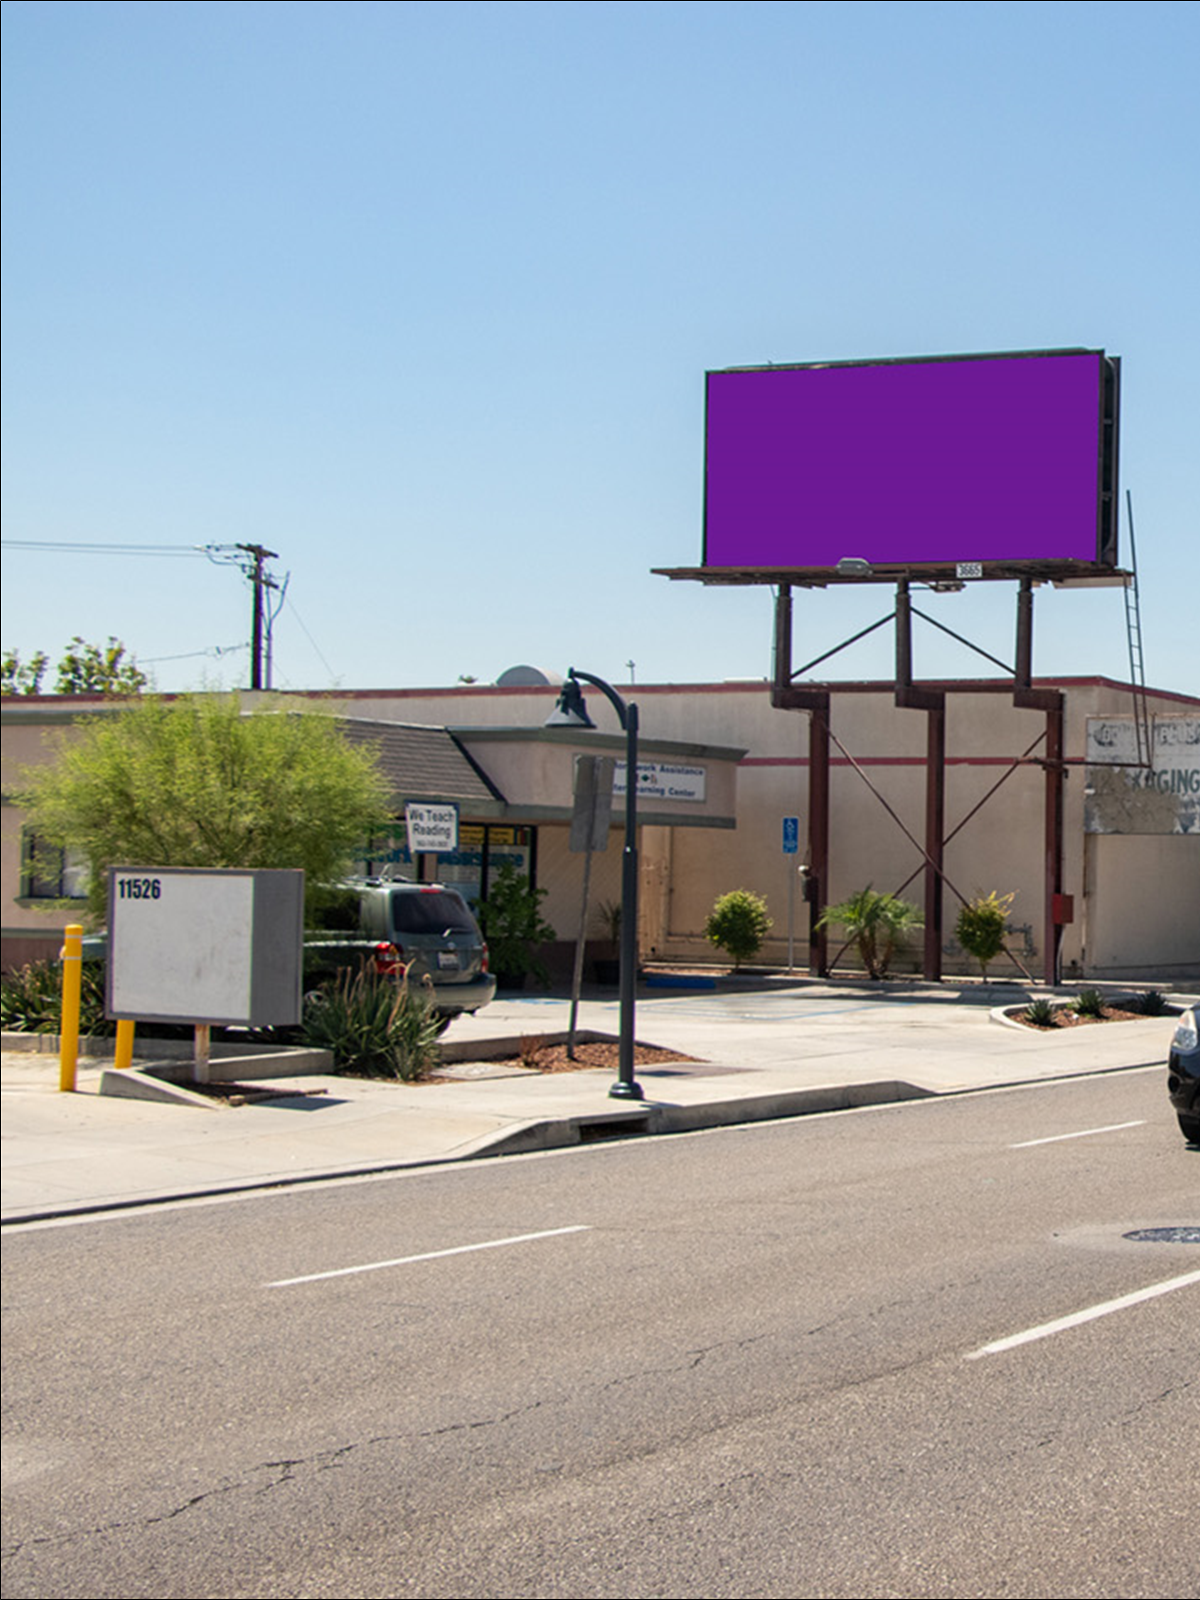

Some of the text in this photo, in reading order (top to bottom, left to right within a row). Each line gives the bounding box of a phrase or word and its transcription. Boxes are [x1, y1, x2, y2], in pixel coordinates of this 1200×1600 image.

[659, 764, 704, 776] Assistance
[668, 787, 696, 797] Center
[409, 809, 454, 822] We Teach
[412, 822, 451, 839] Reading
[118, 878, 162, 900] 11526
